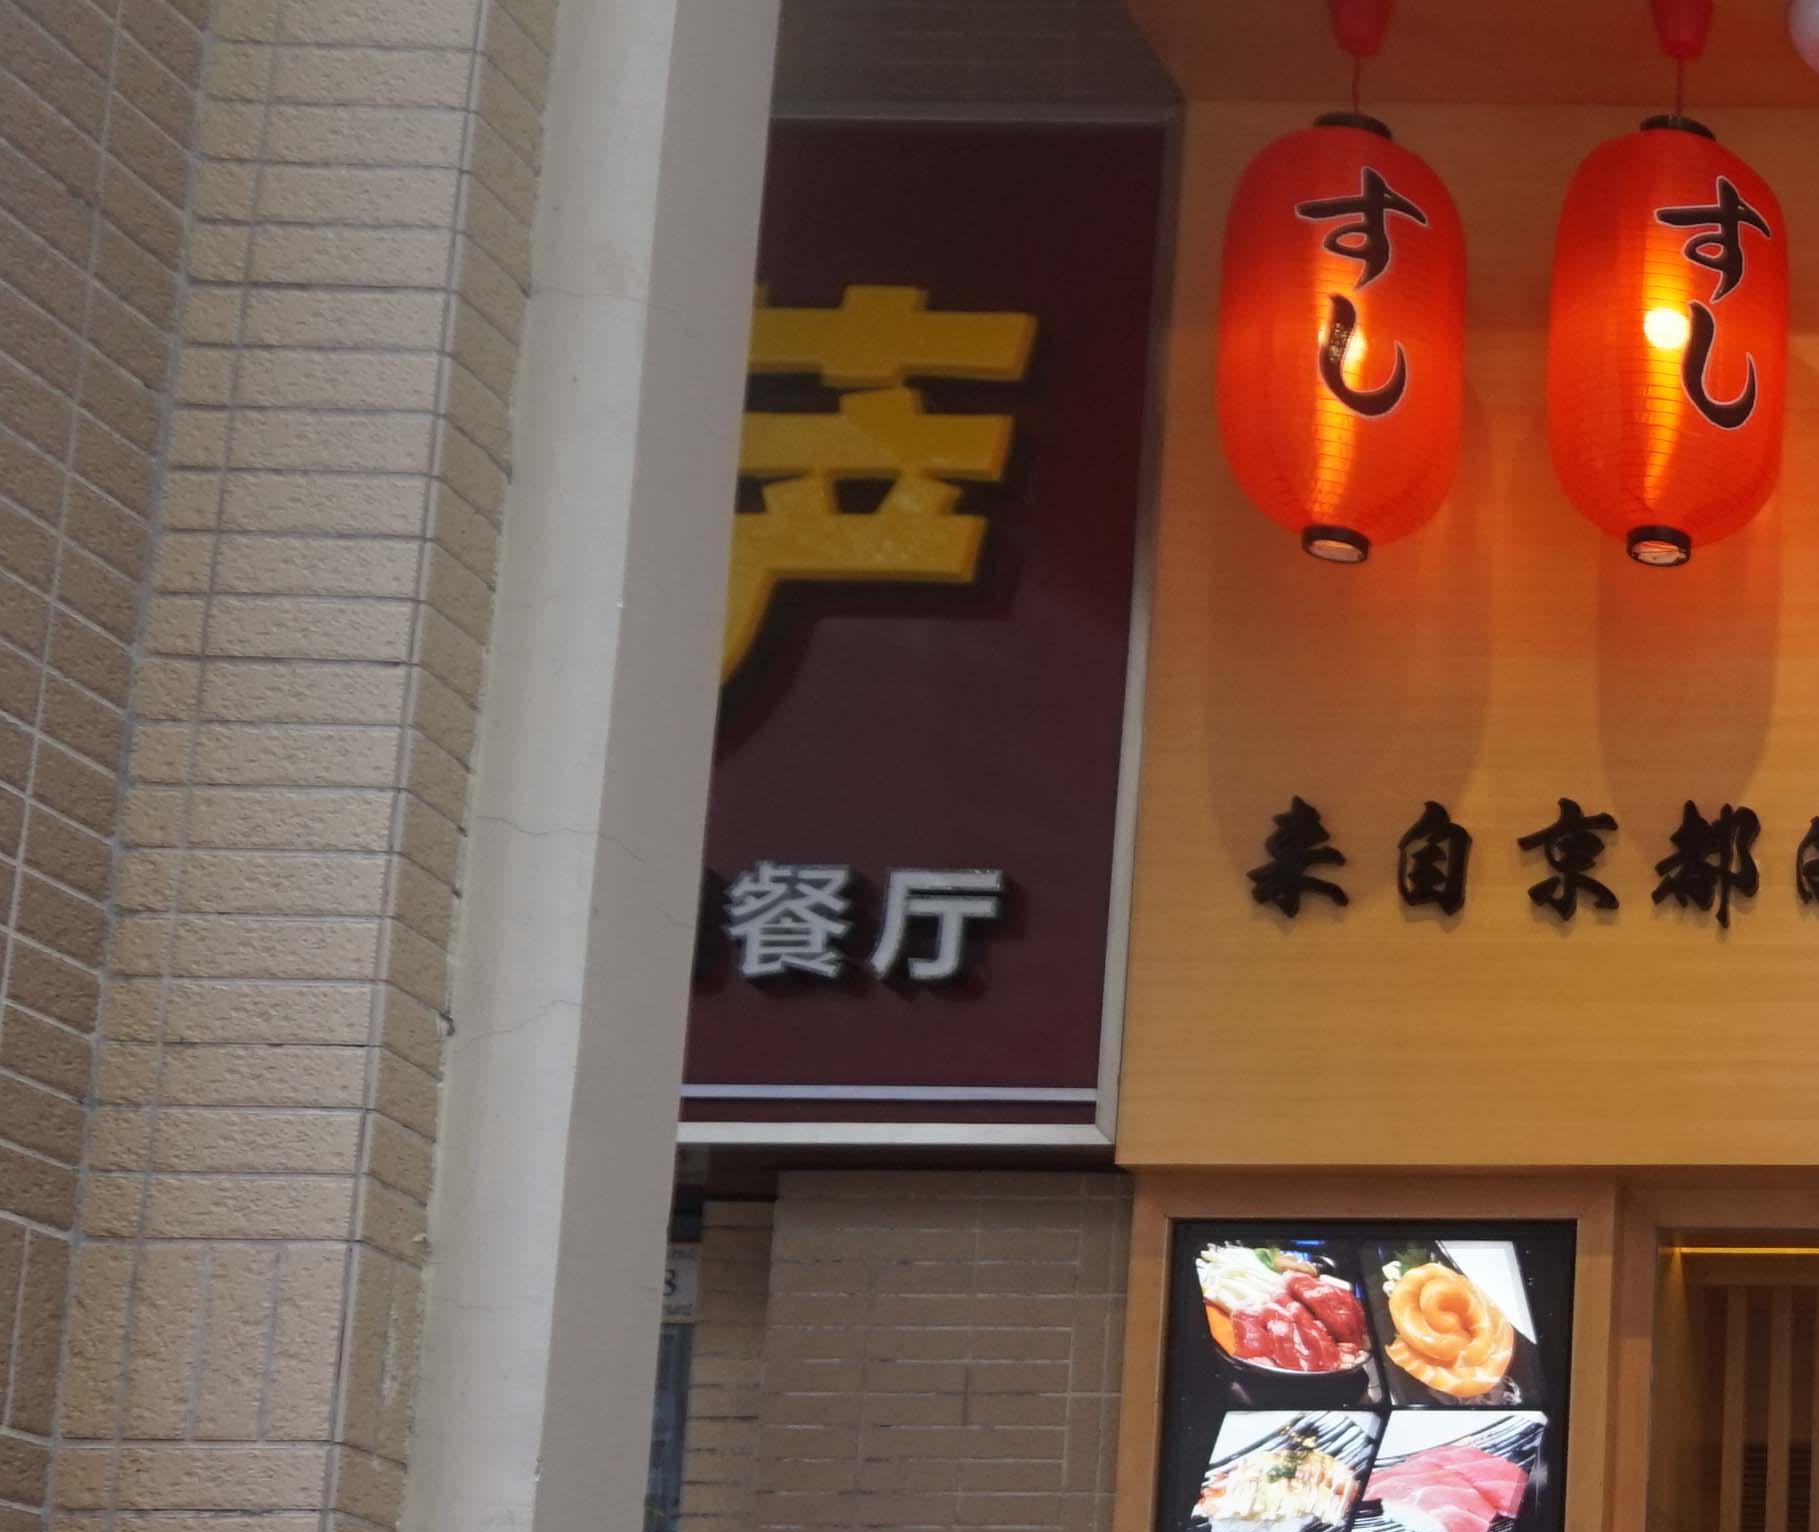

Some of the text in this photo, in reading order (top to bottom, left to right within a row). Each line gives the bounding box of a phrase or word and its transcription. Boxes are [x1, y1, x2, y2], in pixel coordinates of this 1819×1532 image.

[1295, 167, 1429, 417] すし
[1655, 176, 1771, 430] すし
[722, 860, 1005, 984] 餐厅
